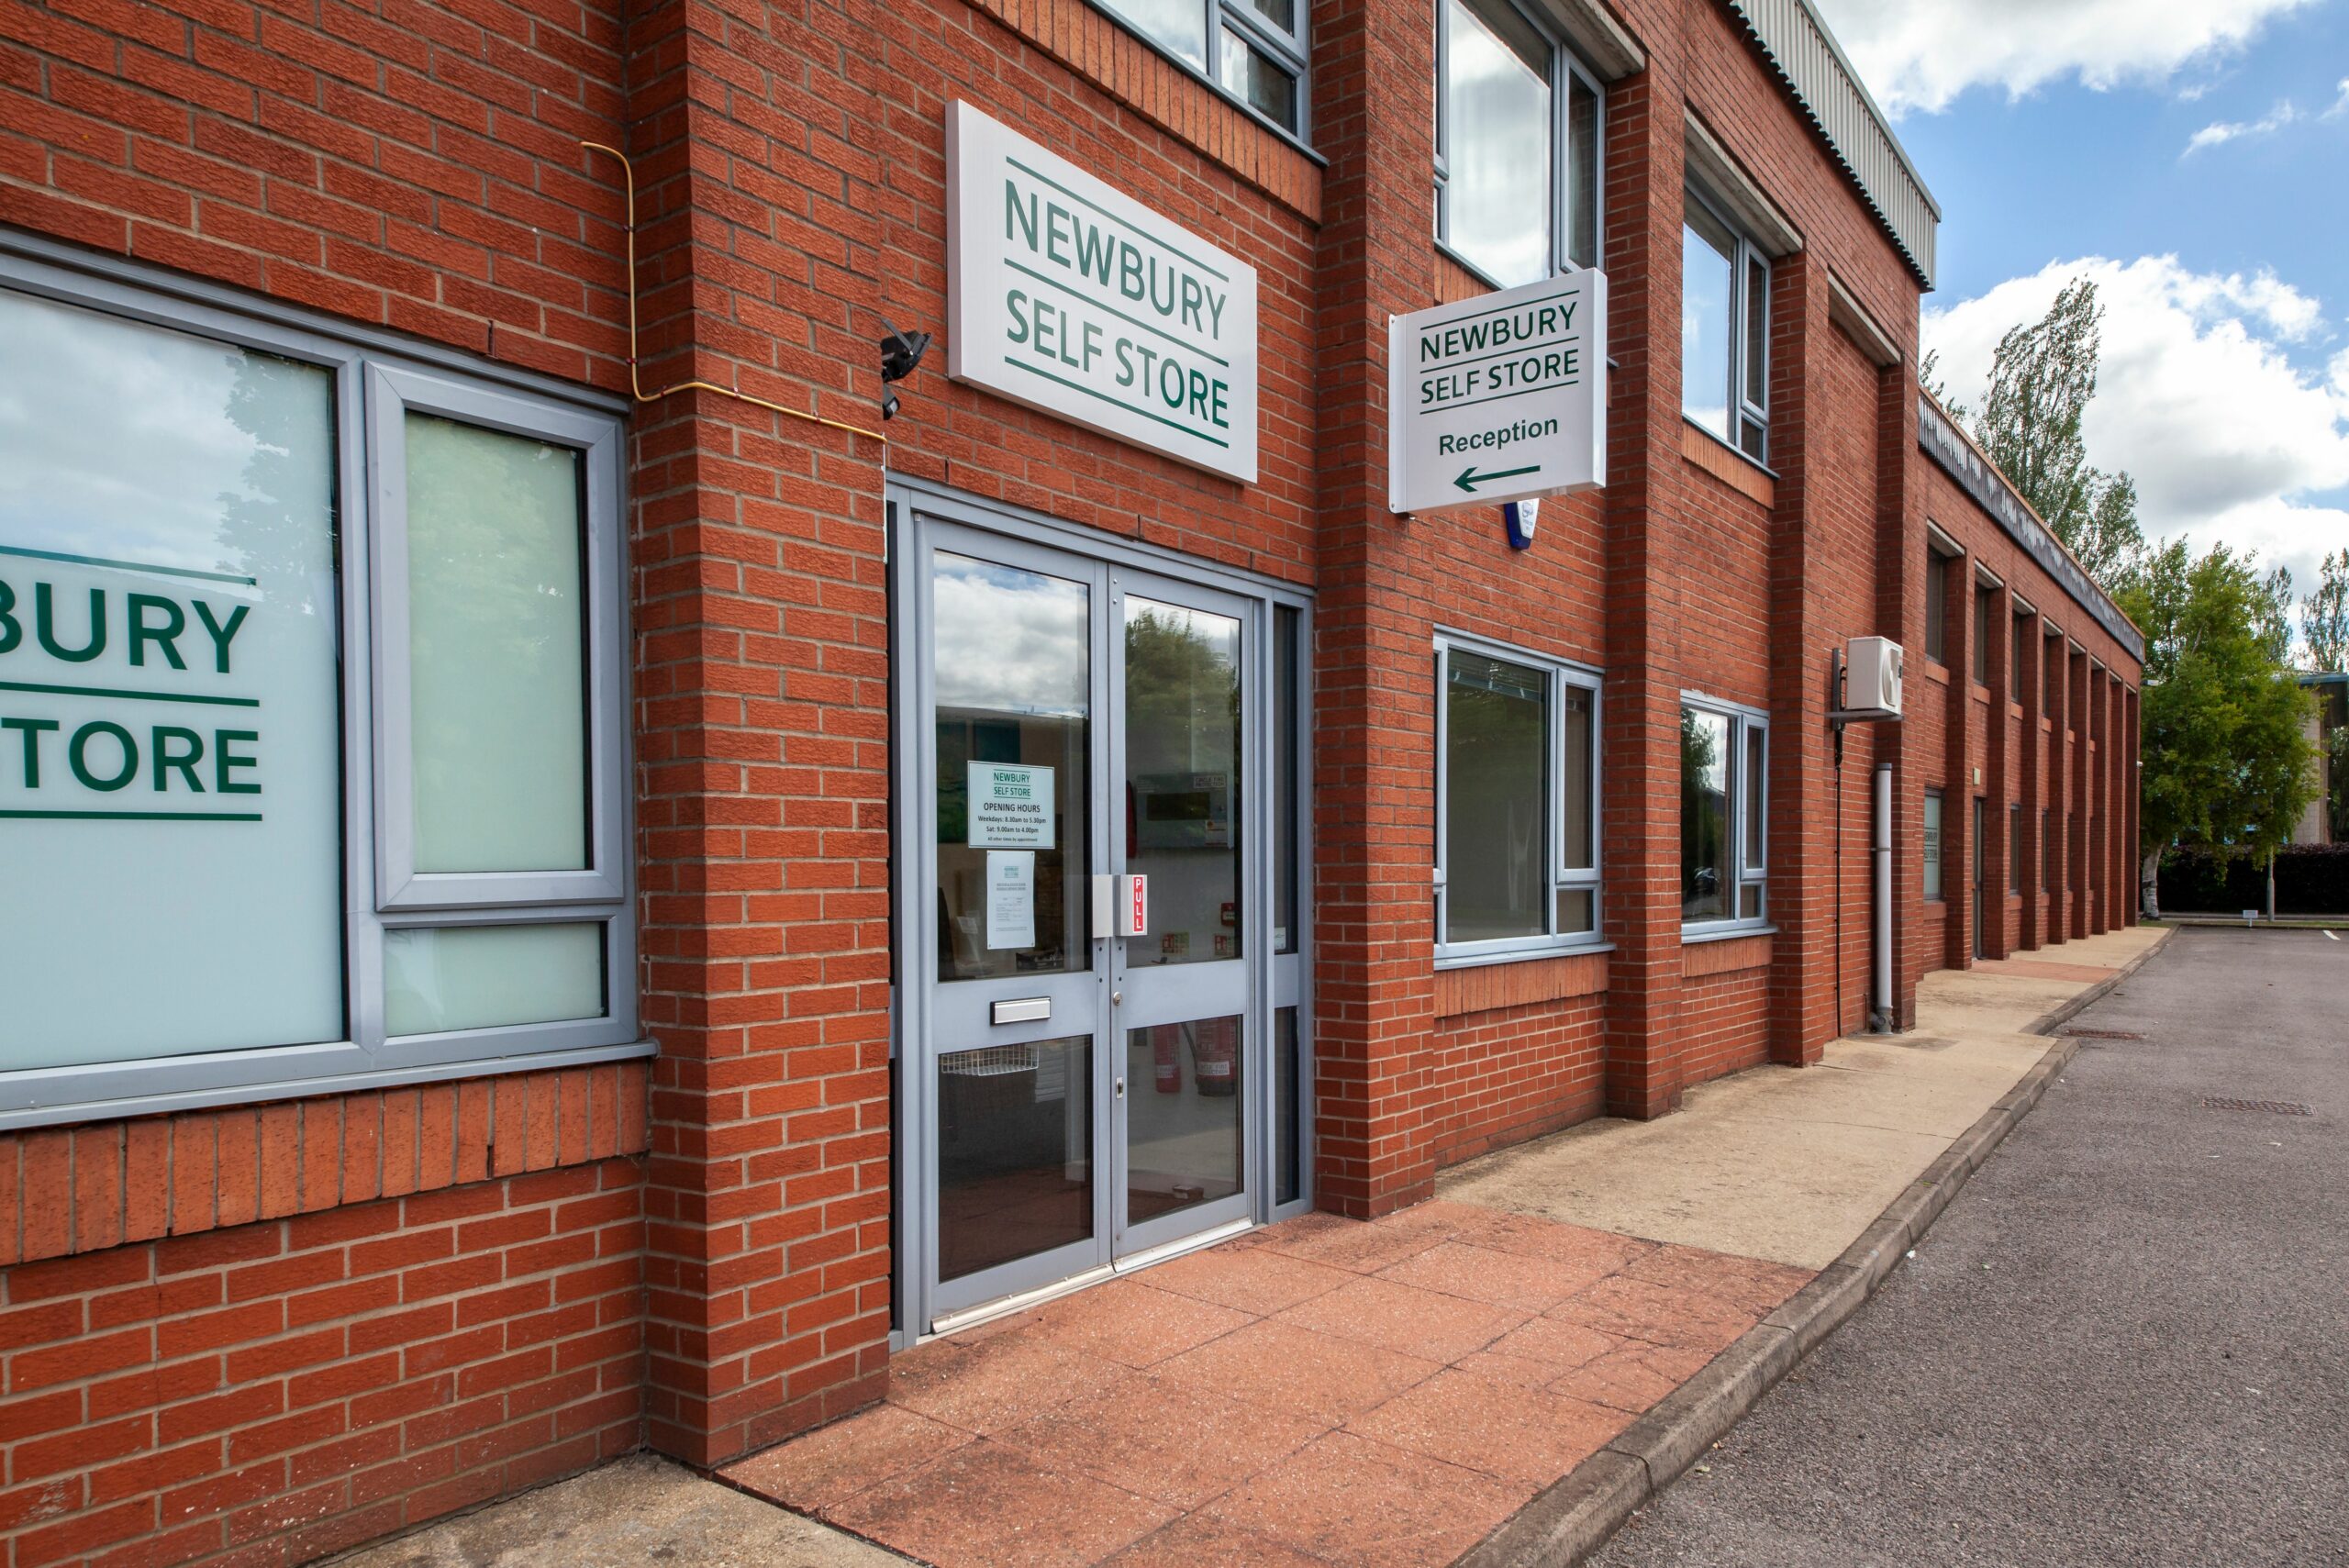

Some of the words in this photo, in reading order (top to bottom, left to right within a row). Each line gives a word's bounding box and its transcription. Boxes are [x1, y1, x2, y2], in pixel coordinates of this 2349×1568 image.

[1006, 179, 1226, 340] NEWBURY
[1007, 289, 1103, 373] SELF
[1115, 337, 1230, 429] STORE
[1420, 301, 1577, 362] NEWBURY
[1420, 370, 1480, 404] SELF
[1488, 349, 1579, 390] STORE
[1439, 418, 1558, 456] Reception
[0, 717, 262, 795] TORE
[994, 772, 1030, 783] NEWBURY
[983, 802, 1016, 812] OPENING
[1017, 804, 1041, 813] HOURS
[994, 786, 1008, 795] SELF
[1010, 787, 1030, 796] STORE
